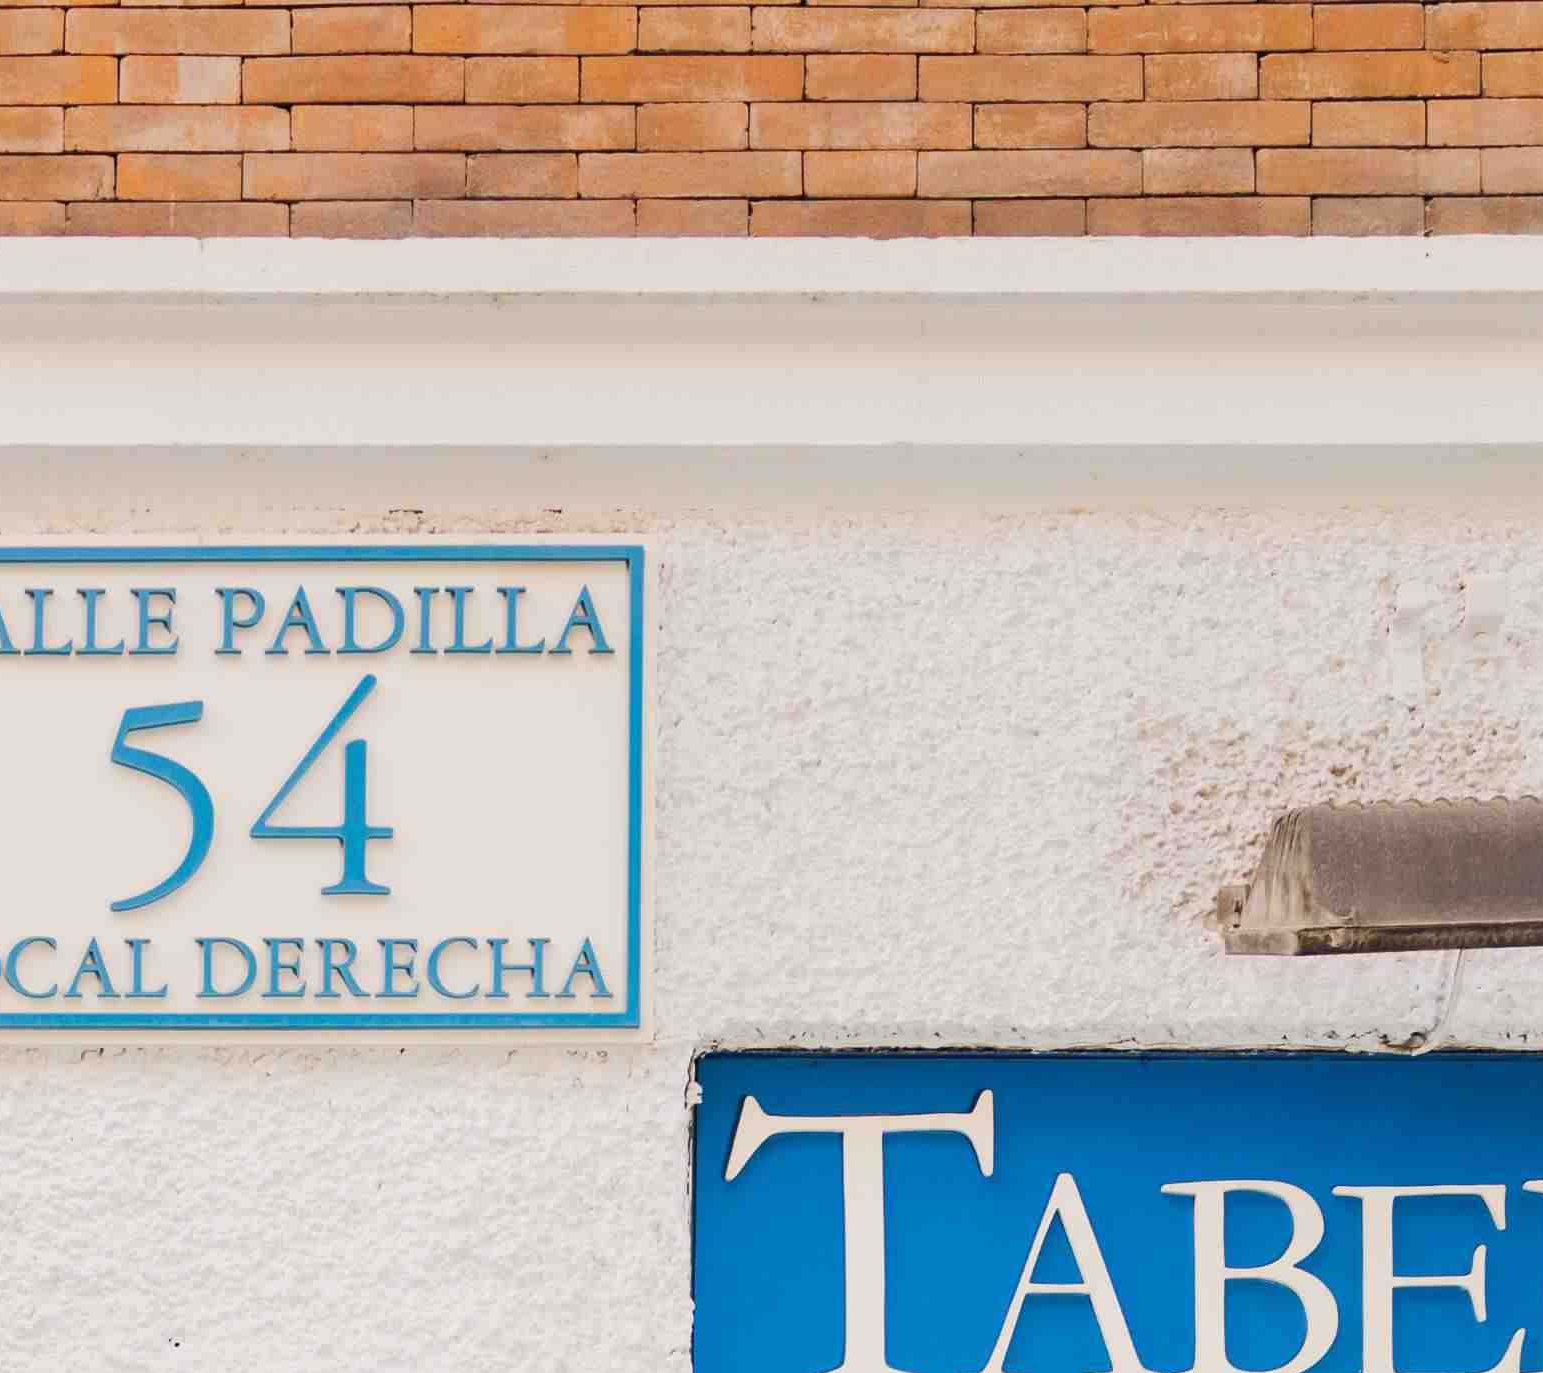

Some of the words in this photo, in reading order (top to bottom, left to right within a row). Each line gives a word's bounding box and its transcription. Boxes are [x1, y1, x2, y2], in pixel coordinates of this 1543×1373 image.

[214, 585, 616, 658] PADILLA
[111, 673, 394, 914] 54
[195, 937, 616, 1001] DERECHA
